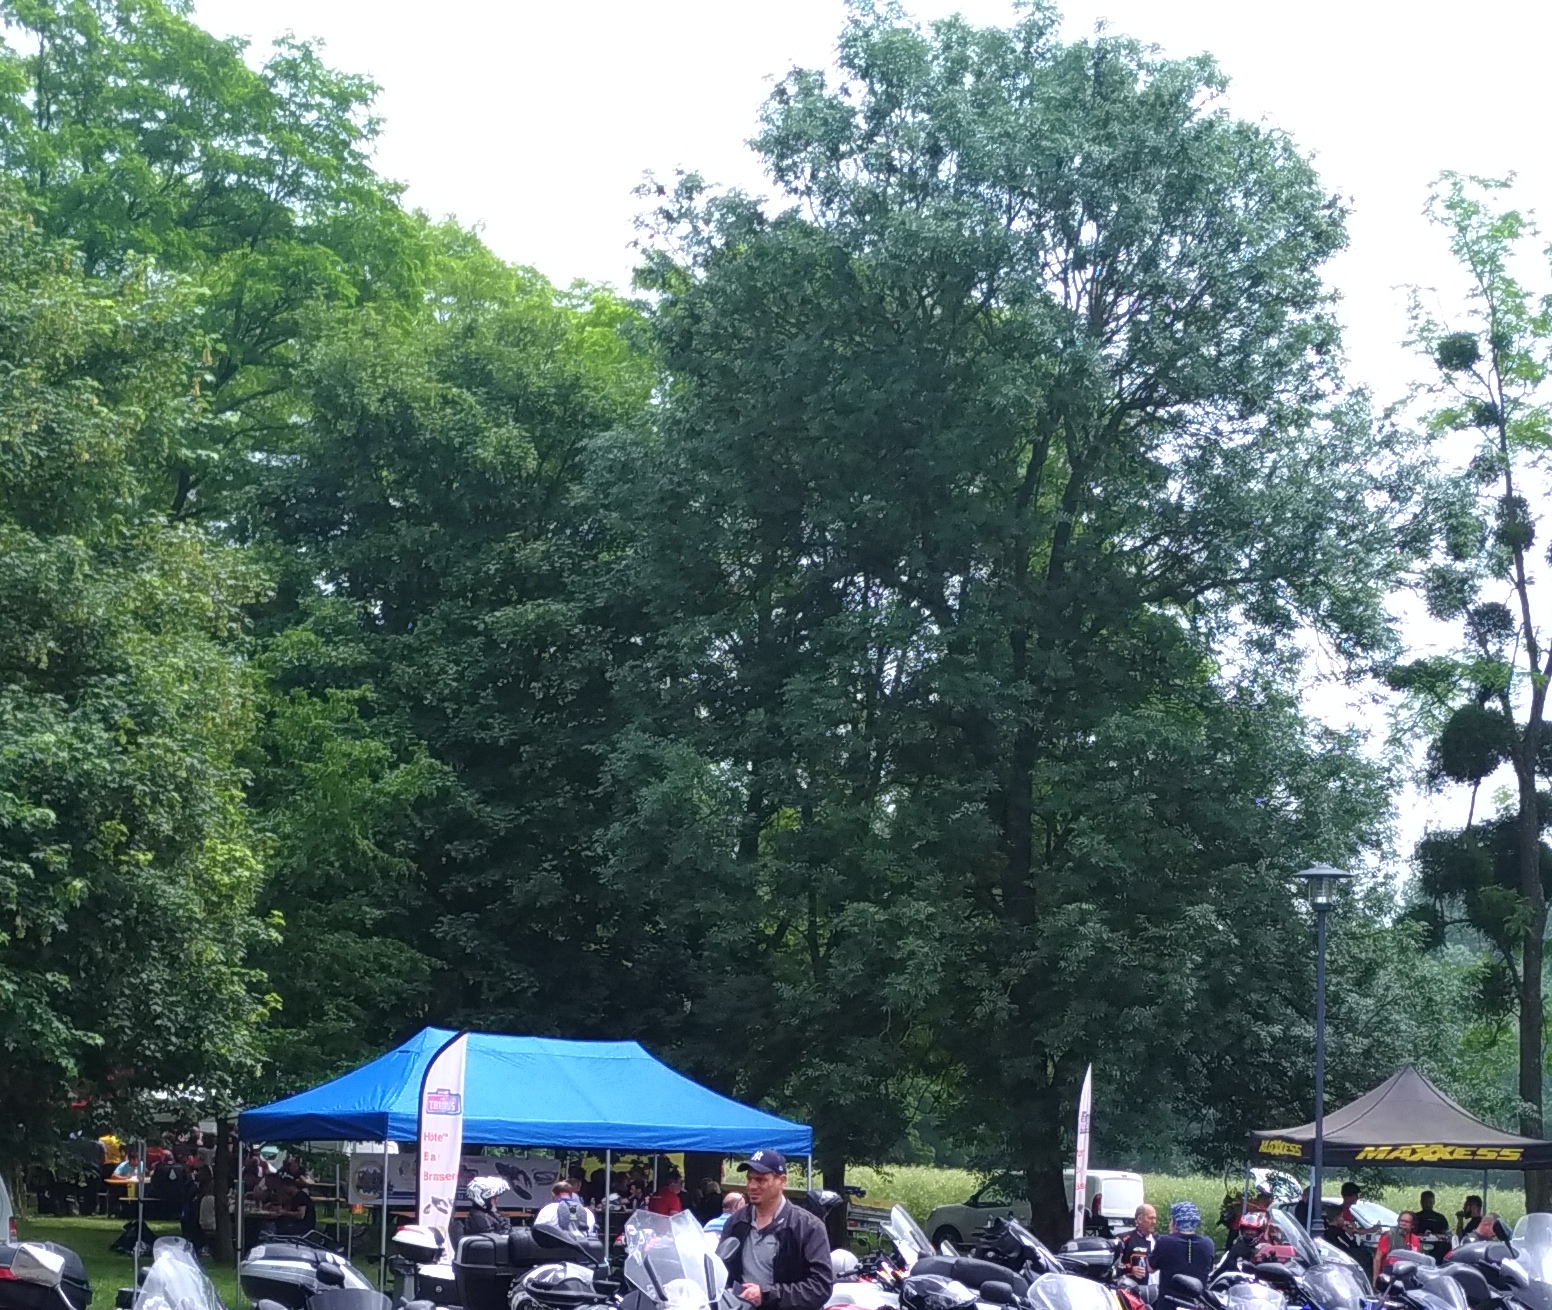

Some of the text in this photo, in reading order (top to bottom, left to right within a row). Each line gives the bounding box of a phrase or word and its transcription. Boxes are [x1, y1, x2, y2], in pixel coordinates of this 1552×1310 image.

[423, 1131, 449, 1143] Hôte
[1258, 1139, 1302, 1157] MAXXESS
[1355, 1144, 1524, 1162] MAXXESS
